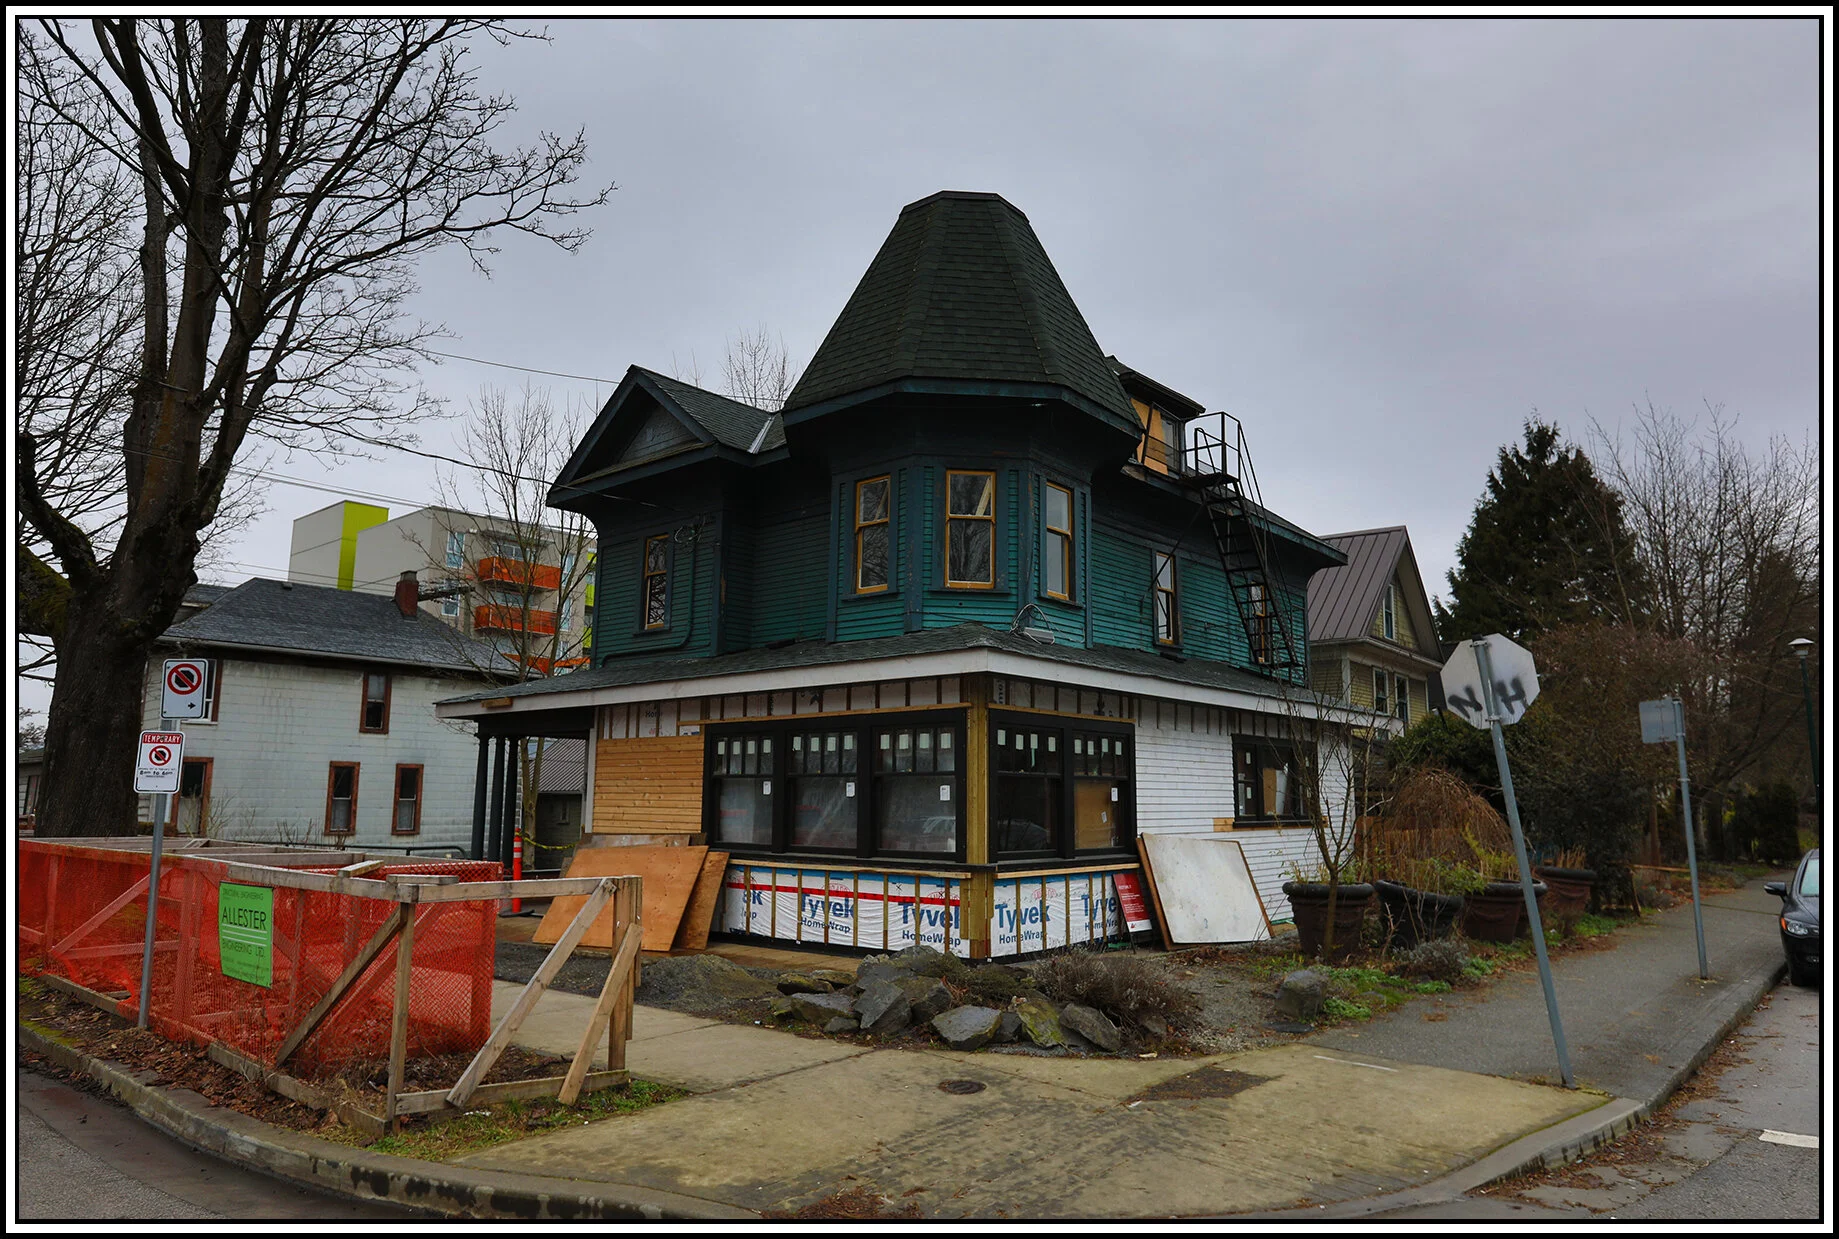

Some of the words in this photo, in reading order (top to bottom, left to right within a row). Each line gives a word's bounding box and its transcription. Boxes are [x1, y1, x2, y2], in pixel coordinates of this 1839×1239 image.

[144, 734, 181, 743] TEMPORARY
[222, 906, 267, 930] ALLESTER
[801, 916, 851, 933] HomeWrap
[995, 901, 1050, 932] Tyvek
[999, 930, 1047, 945] HomeWrap
